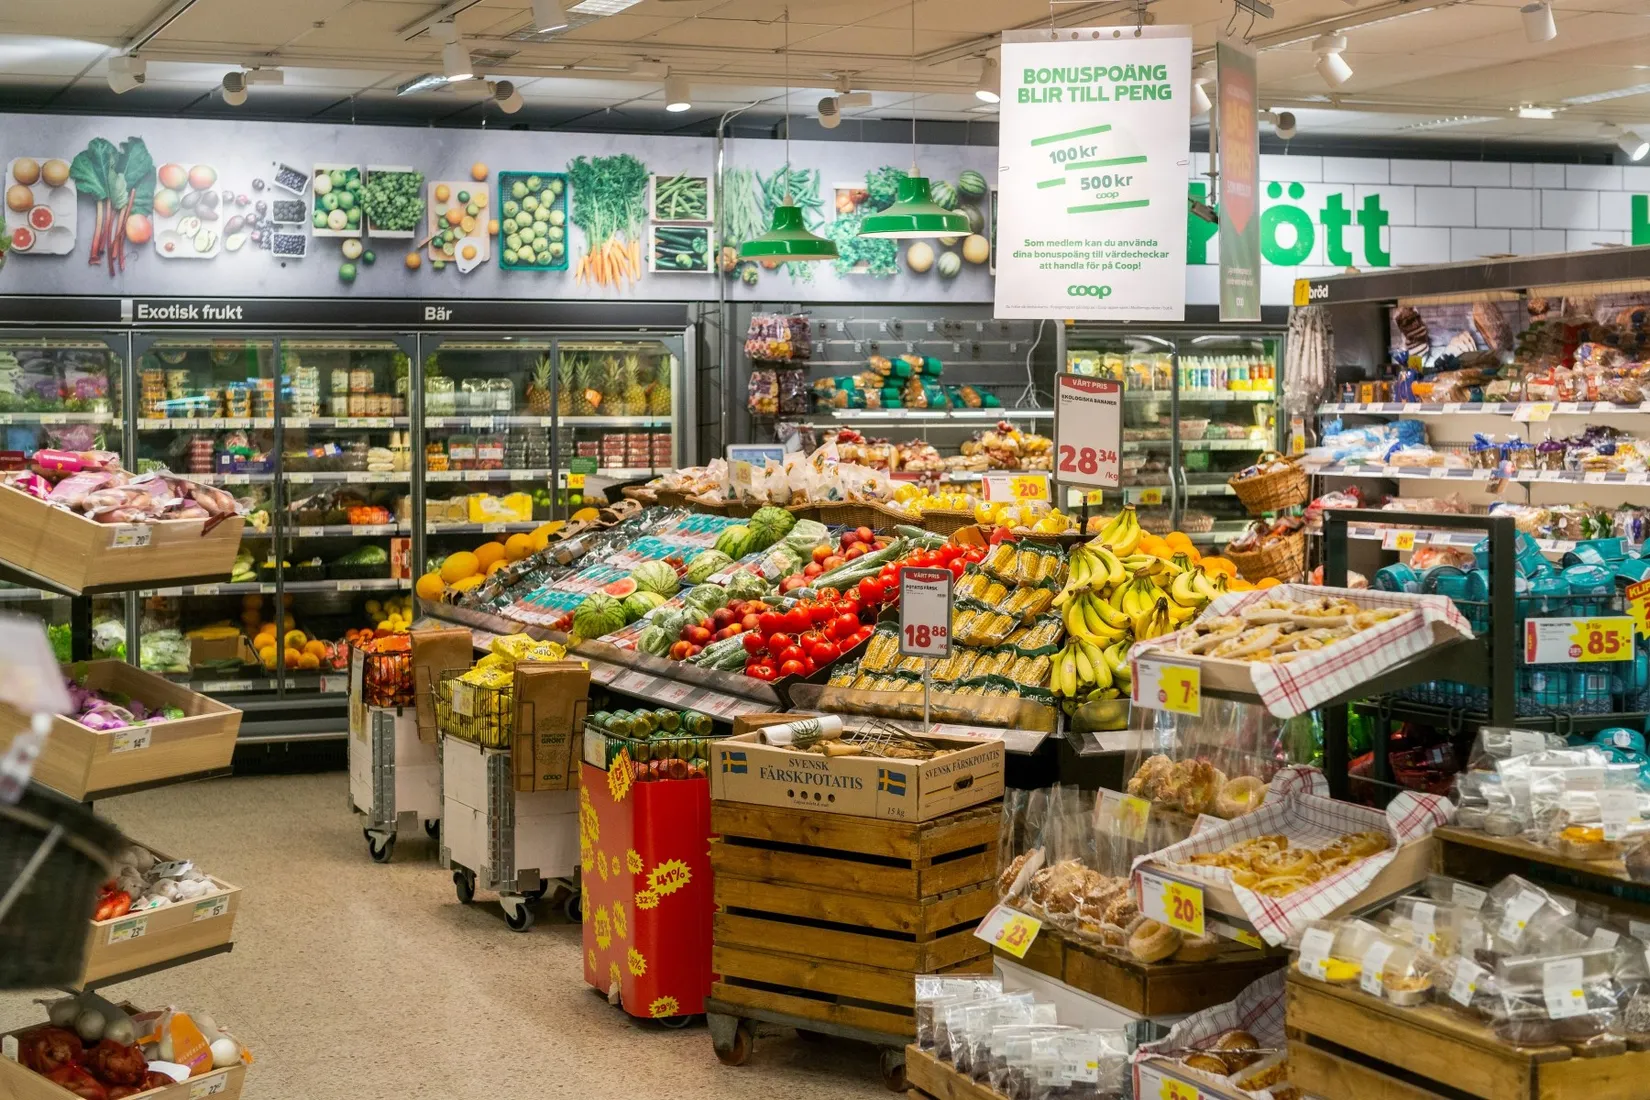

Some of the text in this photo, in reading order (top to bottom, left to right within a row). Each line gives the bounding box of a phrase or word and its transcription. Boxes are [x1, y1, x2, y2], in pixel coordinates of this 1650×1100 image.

[1023, 64, 1168, 85] BONUSPOÄNG
[1018, 83, 1172, 104] BLIR TILL PENG
[1049, 144, 1098, 164] 100 kr
[1080, 173, 1133, 191] 500 kr
[1095, 191, 1119, 200] coop
[1024, 239, 1158, 247] Som medlem kan du använda
[1012, 250, 1170, 260] dina bonuspoäng till värdecheckar
[1039, 261, 1141, 271] att handla för på Coop!
[1067, 285, 1112, 299] coop
[137, 304, 243, 321] Exotisk frukt
[424, 305, 453, 321] Bär
[1072, 379, 1108, 390] VÅRT PRIS
[1061, 394, 1093, 403] EKOLOGISKA
[1094, 398, 1117, 406] BANANER
[1059, 444, 1117, 475] 28 34
[904, 624, 947, 648] 18 88
[789, 757, 829, 772] SVENSK
[925, 749, 1000, 780] SVENSK FÄRSKPOTATIS
[760, 765, 863, 790] FÄRSKPOTATIS
[887, 805, 905, 818] 15 kg
[656, 867, 686, 886] 41%
[638, 896, 656, 904] 32%
[654, 1001, 676, 1014] 29%
